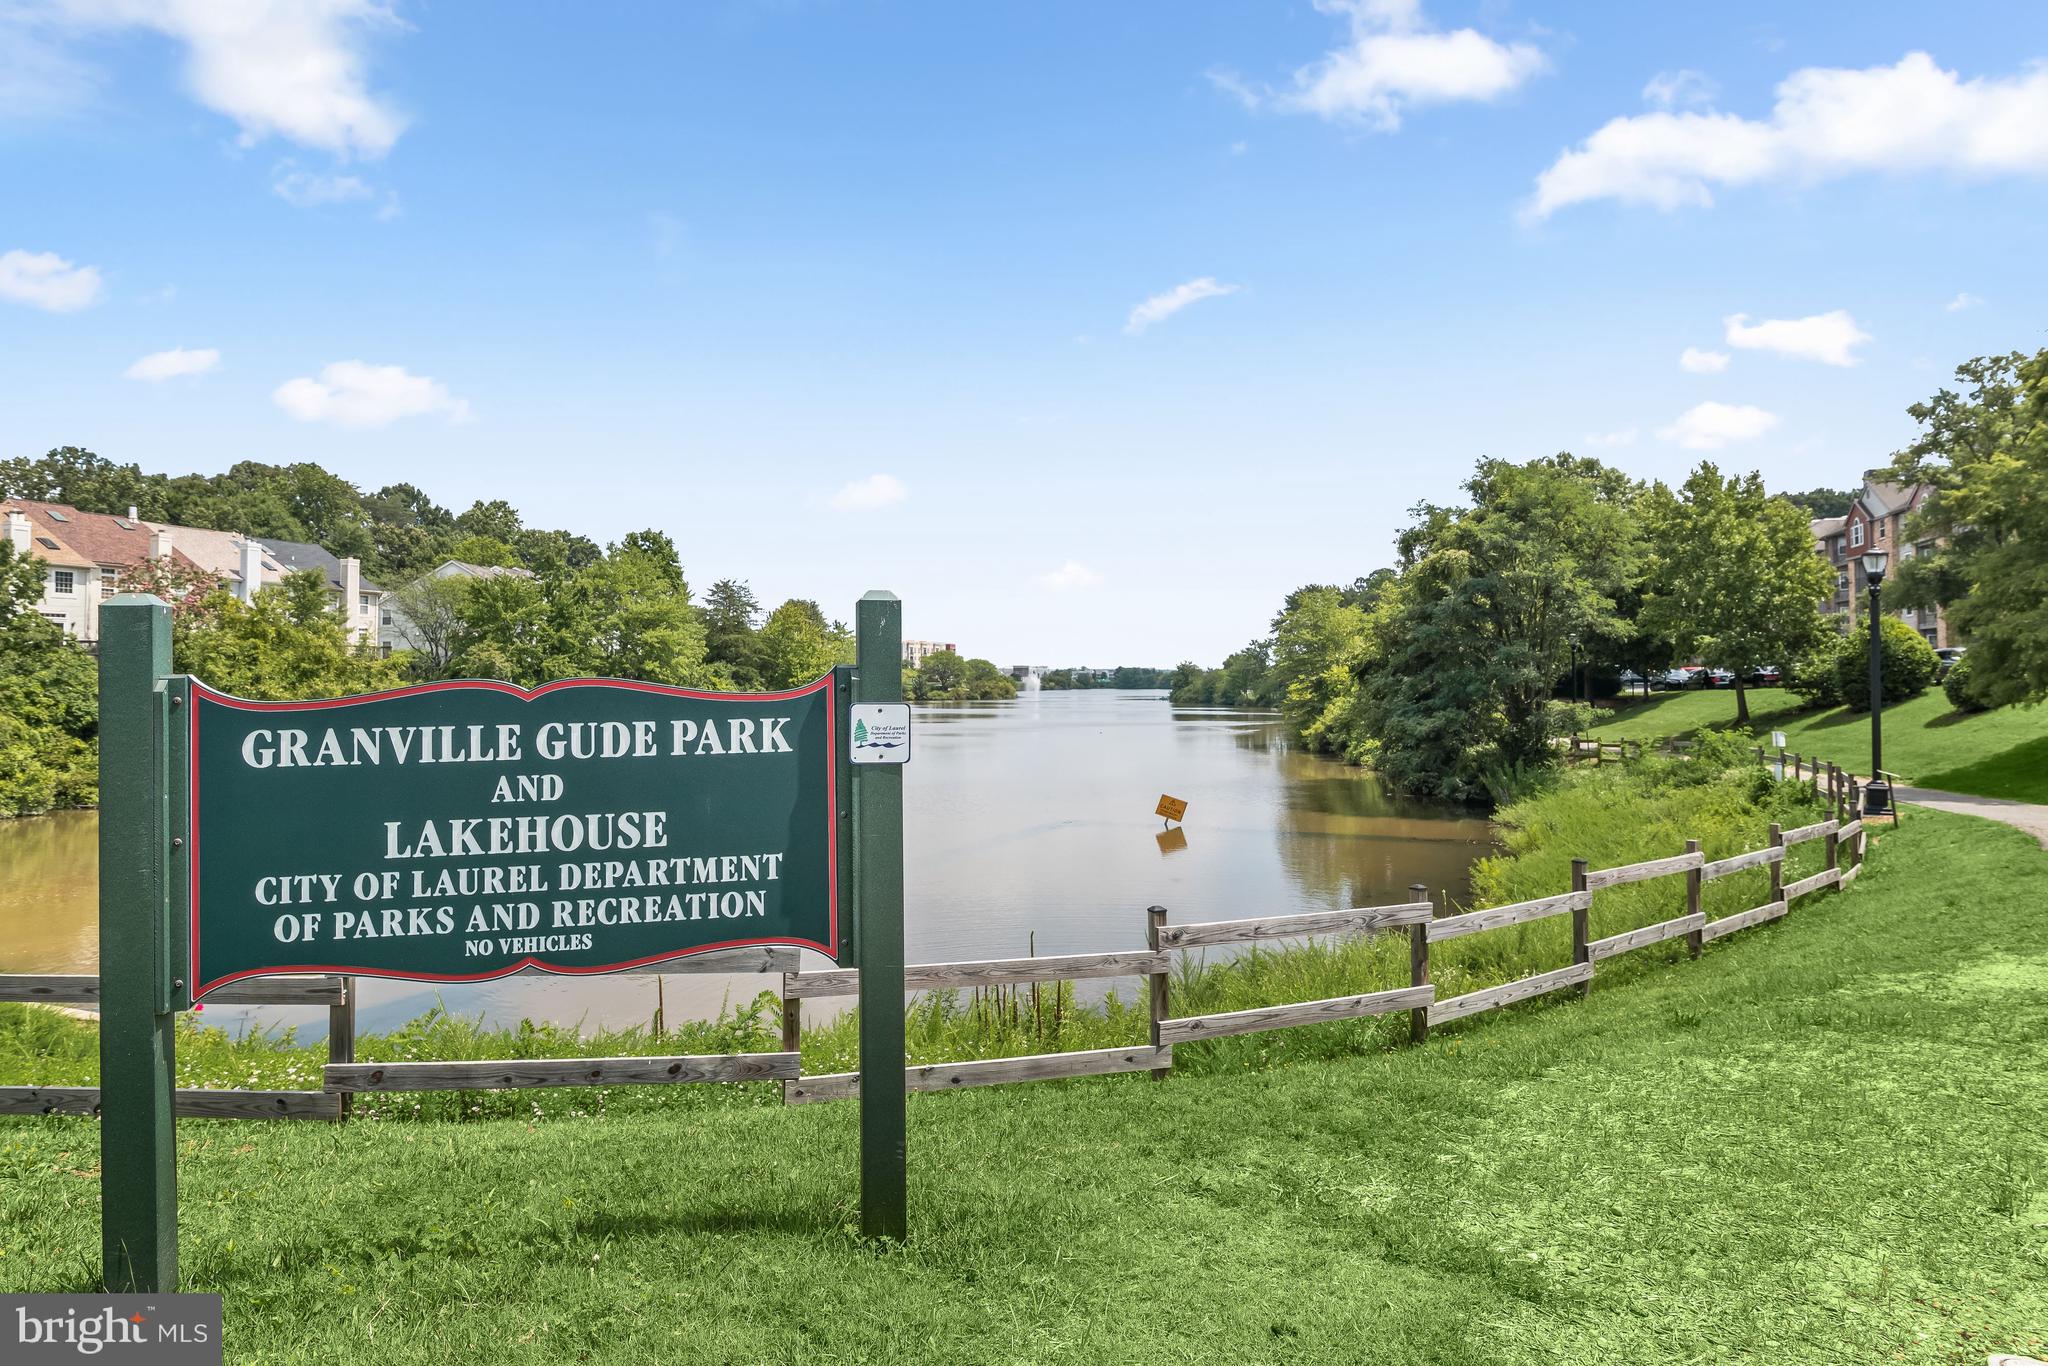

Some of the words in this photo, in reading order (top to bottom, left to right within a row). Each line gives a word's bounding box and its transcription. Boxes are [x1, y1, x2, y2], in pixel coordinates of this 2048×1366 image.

[241, 724, 522, 769] GRANVILLE
[535, 720, 657, 760] GUDE
[670, 717, 794, 756] PARK
[491, 774, 564, 803] AND
[383, 811, 668, 859] LAKEHOUSE
[254, 873, 343, 906] CITY
[353, 871, 400, 901] OF
[411, 864, 548, 898] LAUREL
[558, 852, 783, 891] DEPARTMENT
[273, 913, 322, 943] OF
[333, 906, 455, 940] PARKS
[465, 902, 540, 933] AND
[551, 890, 767, 928] RECREATION
[464, 939, 494, 957] NO
[498, 933, 593, 955] VEHICLES
